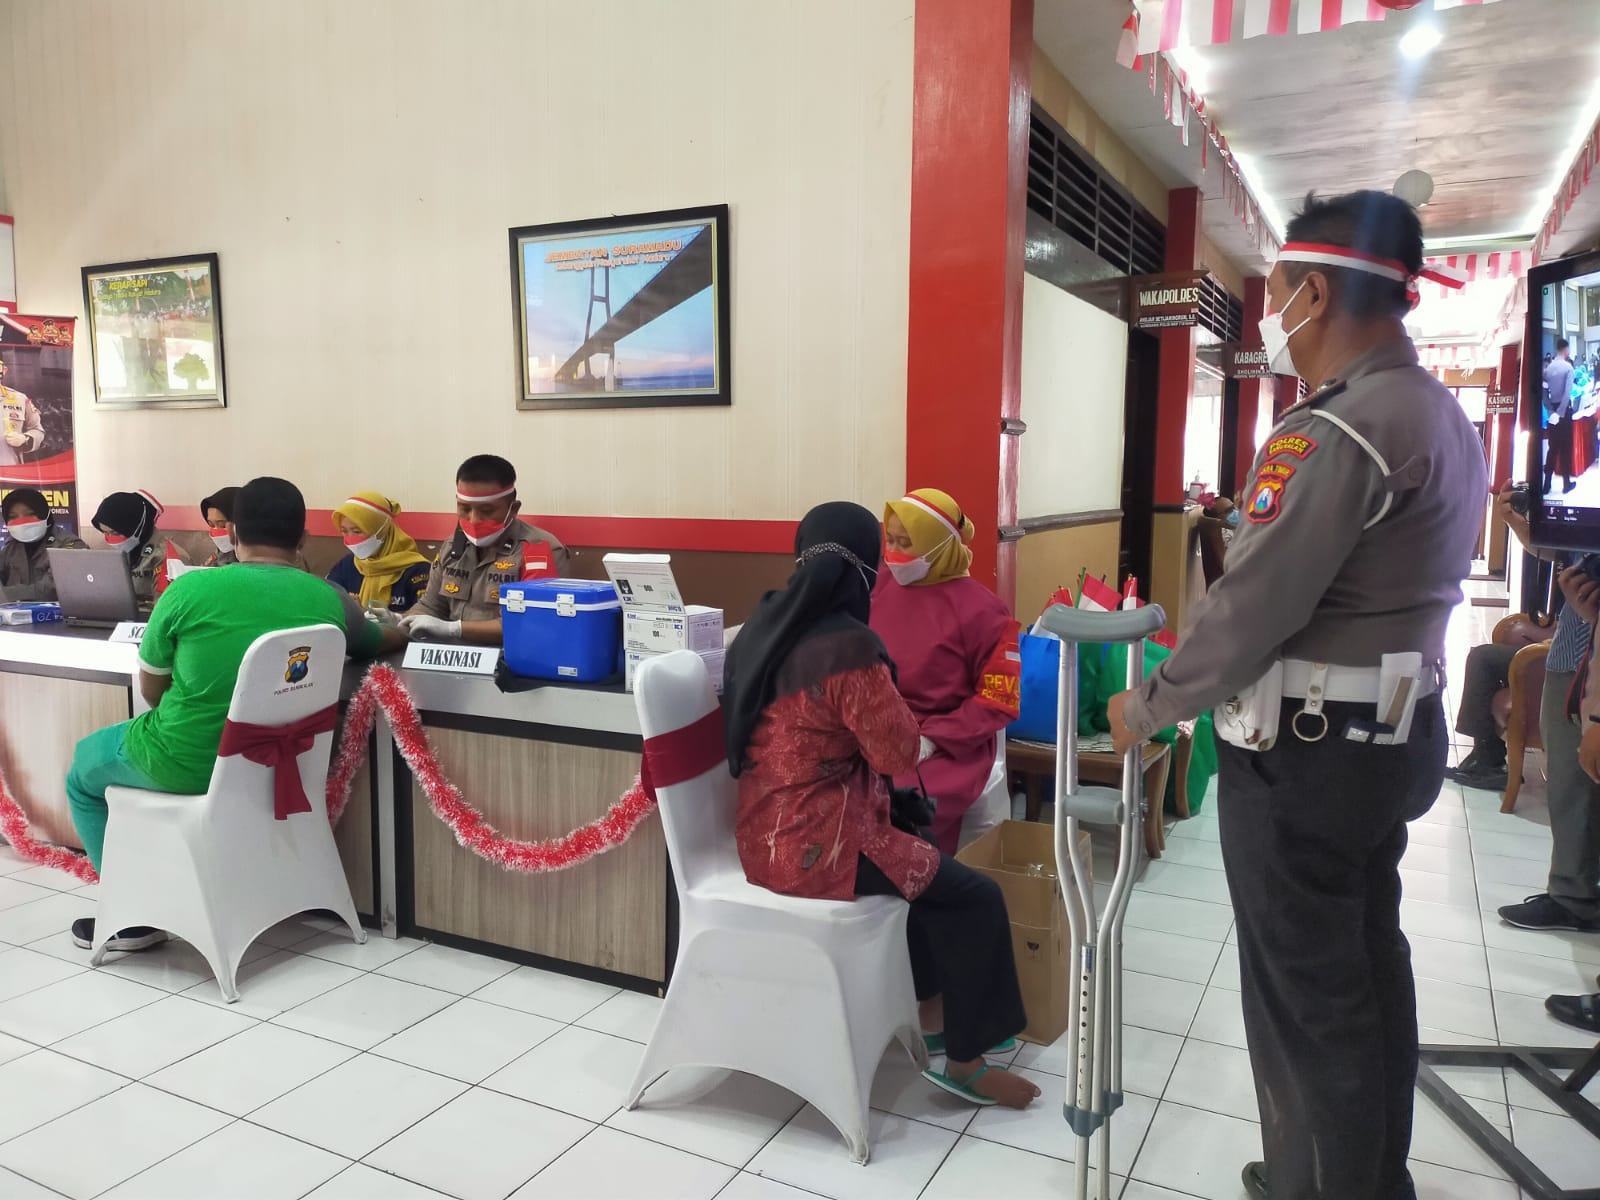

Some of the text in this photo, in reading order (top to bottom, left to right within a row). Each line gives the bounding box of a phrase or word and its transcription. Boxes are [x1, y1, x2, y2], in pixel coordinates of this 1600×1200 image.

[612, 240, 682, 256] SURAMADU
[1140, 287, 1199, 306] WAKAPOLRES
[1234, 351, 1268, 365] KABAGRE
[420, 648, 482, 668] VAKSINASI
